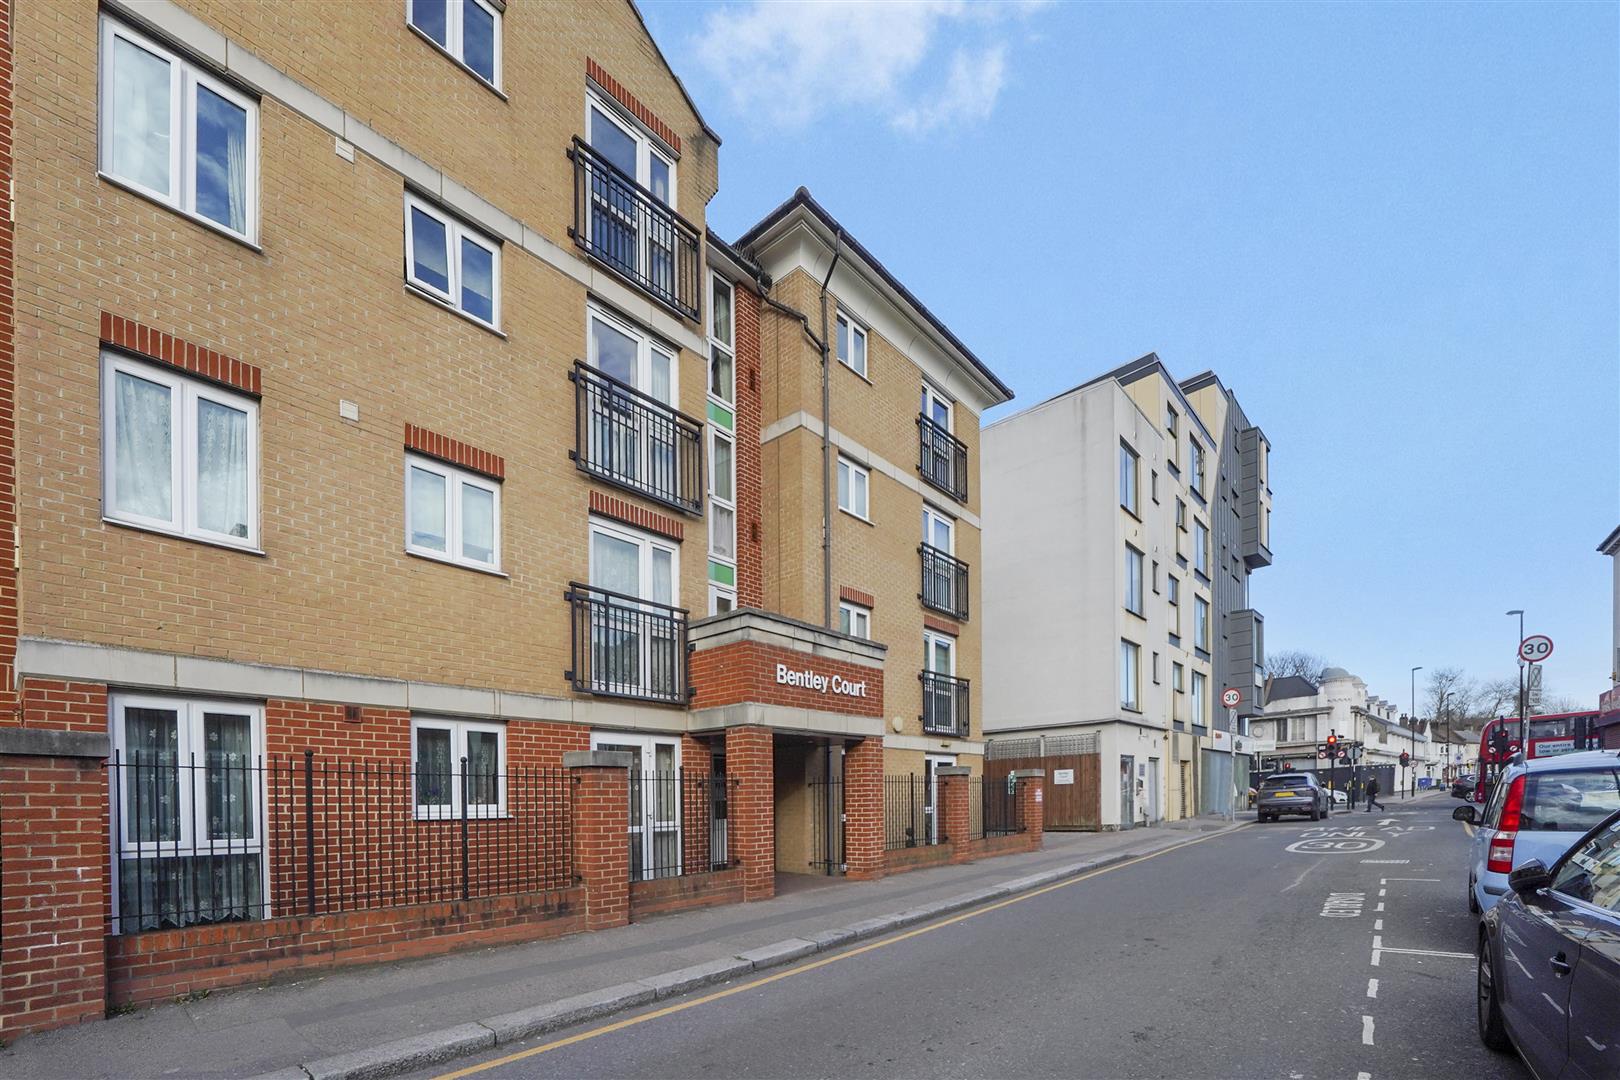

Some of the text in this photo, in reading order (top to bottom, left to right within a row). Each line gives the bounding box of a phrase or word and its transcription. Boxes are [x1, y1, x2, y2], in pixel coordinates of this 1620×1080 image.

[1523, 642, 1549, 655] 30
[776, 664, 866, 697] Bentley Court
[1225, 693, 1239, 702] 30
[1301, 841, 1368, 849] 30
